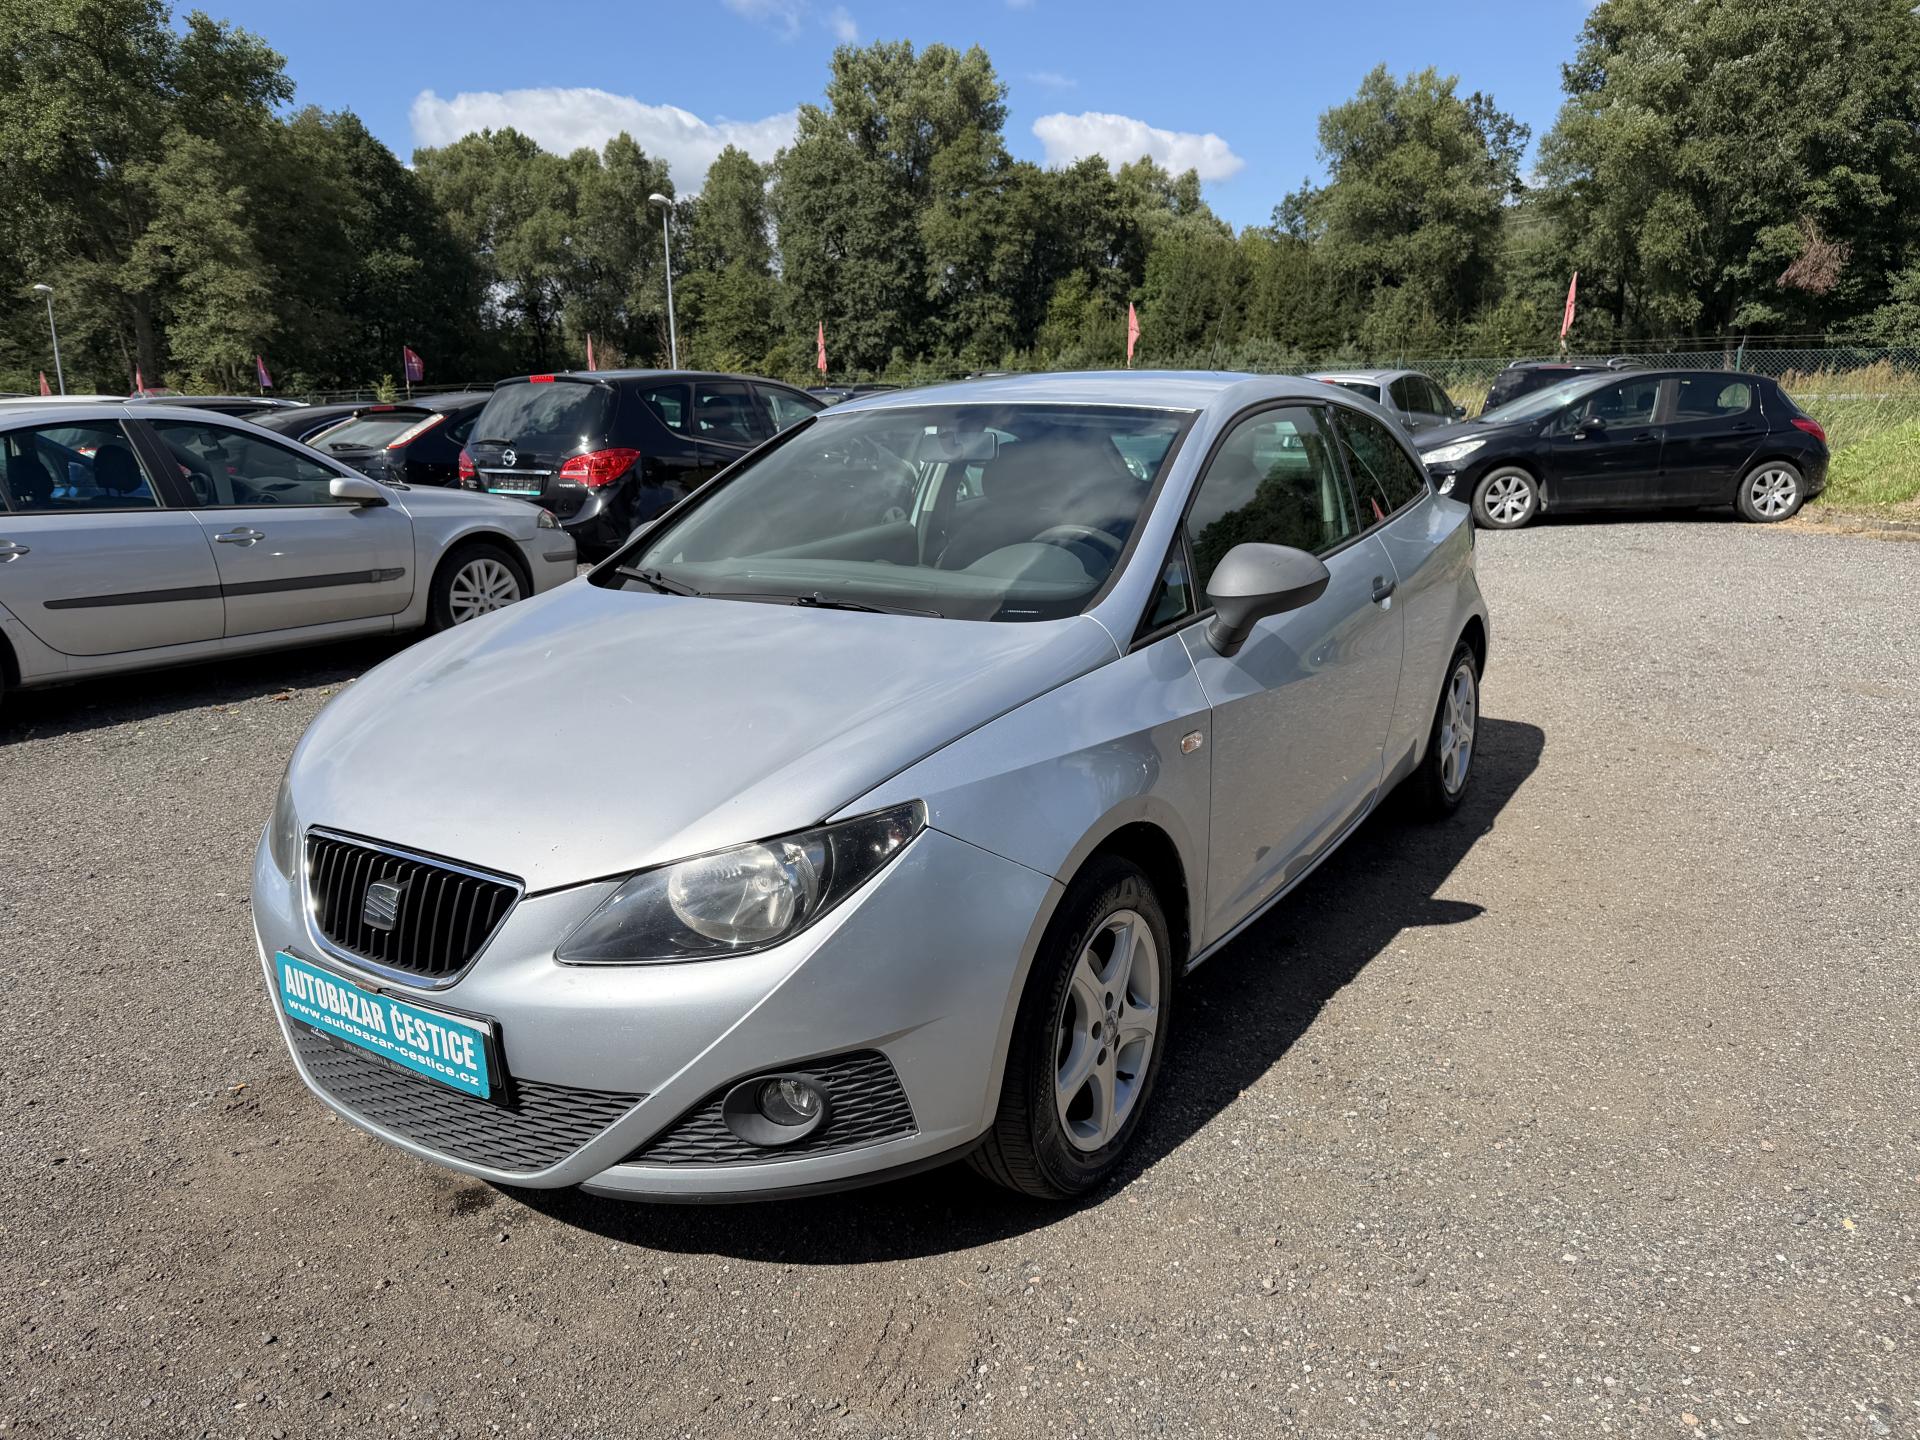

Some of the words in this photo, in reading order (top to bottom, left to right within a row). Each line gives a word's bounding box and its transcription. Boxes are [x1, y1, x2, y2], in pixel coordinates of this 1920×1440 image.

[284, 964, 387, 1035] AUTOBAZAR
[389, 1003, 478, 1071] ČESTICE
[287, 998, 479, 1087] www.autobazar-cestice.cz
